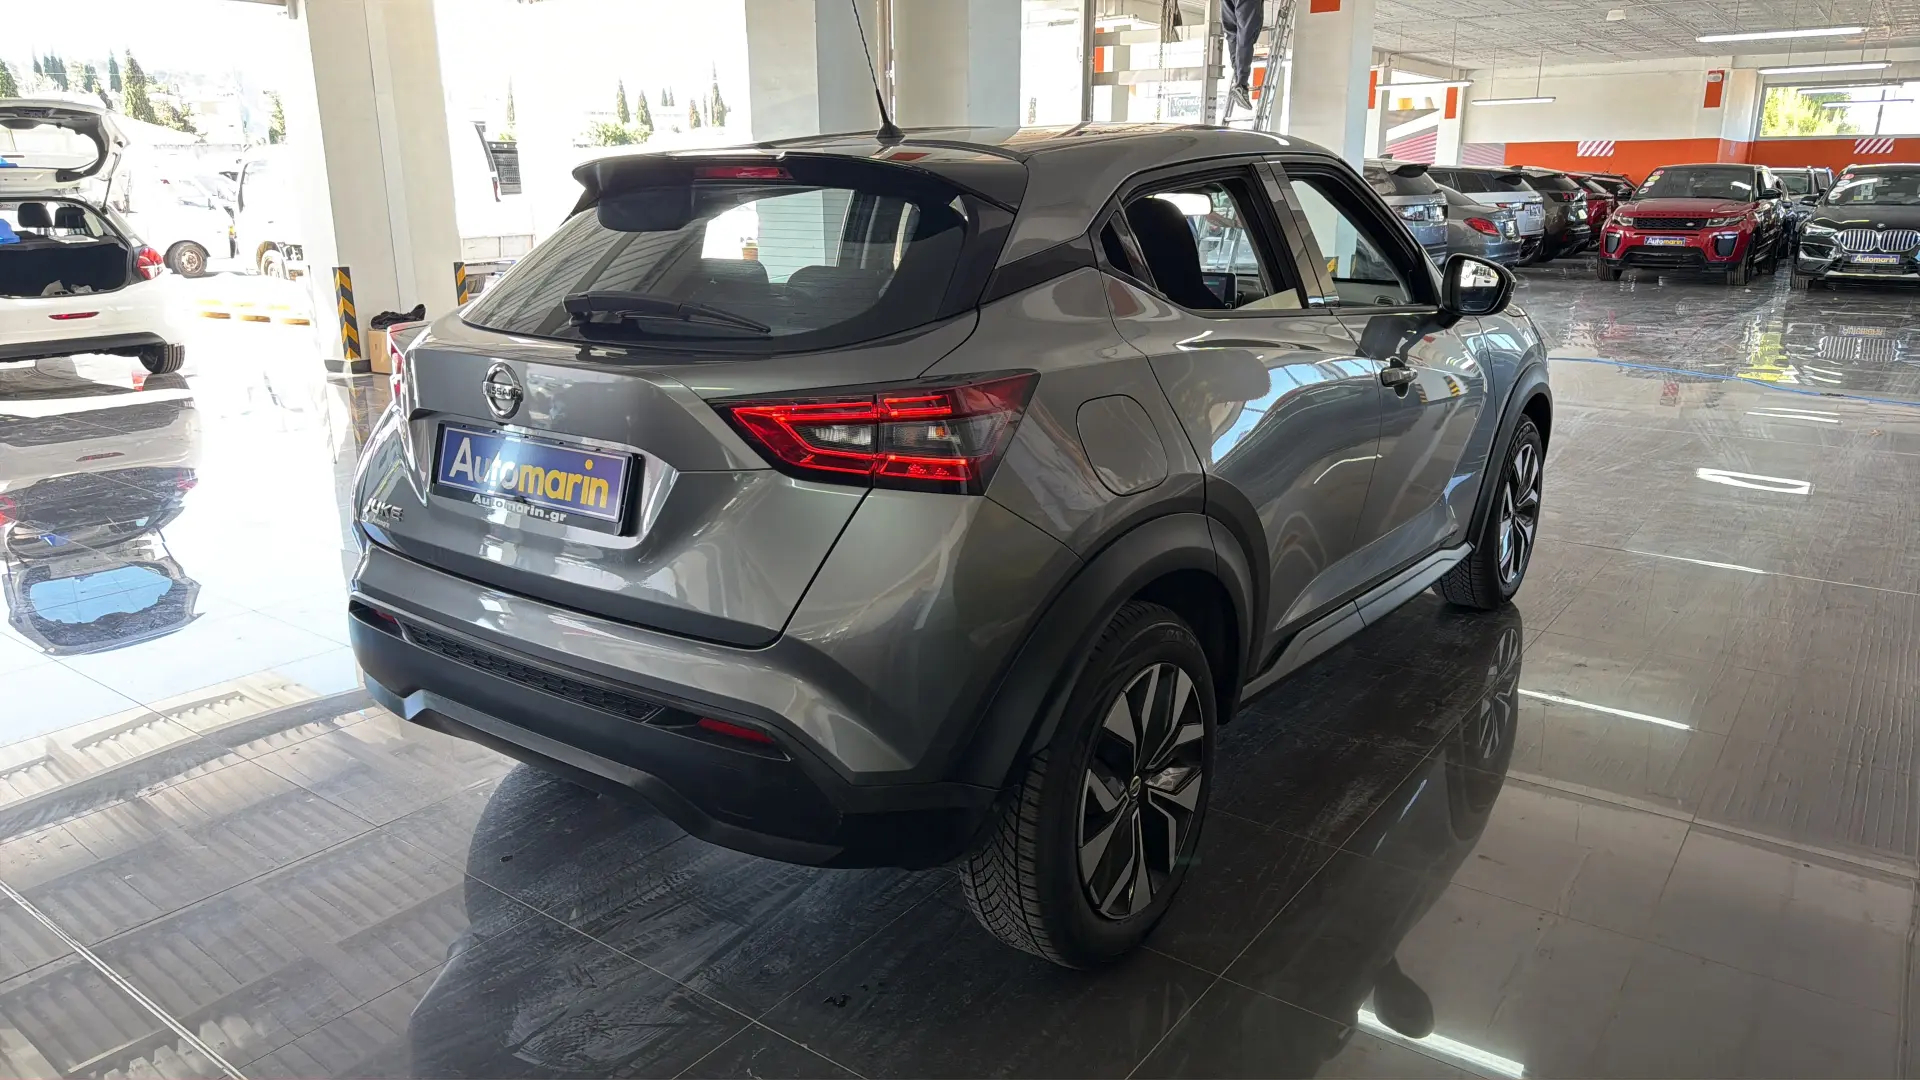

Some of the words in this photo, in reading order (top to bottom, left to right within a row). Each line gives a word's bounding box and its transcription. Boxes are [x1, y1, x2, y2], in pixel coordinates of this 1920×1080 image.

[1646, 237, 1683, 245] Automarin
[1855, 254, 1897, 263] Automarin
[485, 384, 519, 399] NISSAN
[449, 437, 609, 509] Automarin
[363, 498, 404, 522] JUKE
[472, 493, 567, 523] Automarin.gr
